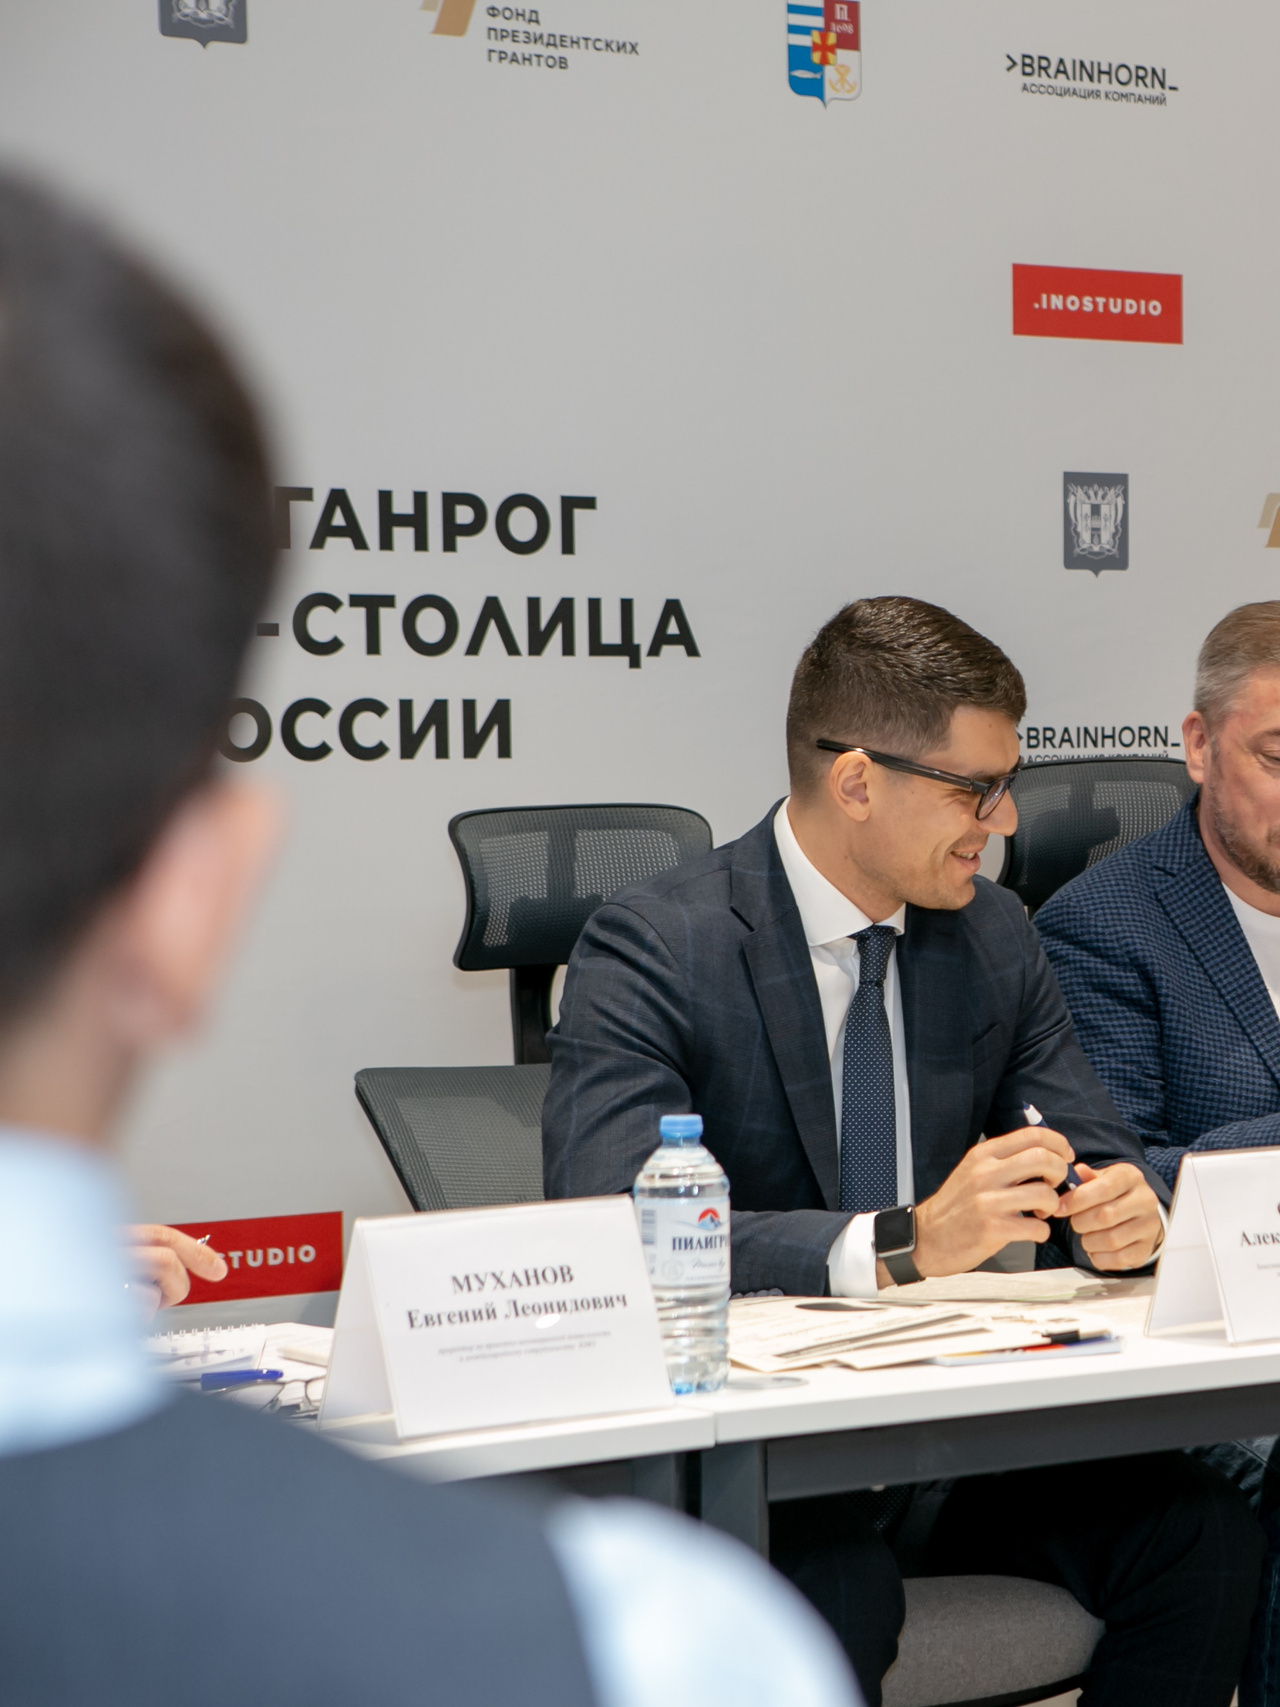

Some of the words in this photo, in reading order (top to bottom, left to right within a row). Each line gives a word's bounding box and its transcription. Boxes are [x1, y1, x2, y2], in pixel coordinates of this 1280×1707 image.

[486, 5, 541, 26] ФОНД
[486, 27, 640, 56] ПРЕЗИДЕНТСКИХ
[487, 49, 569, 70] ГРАНТОВ
[1021, 82, 1101, 100] АССОЦИАЦИЯ
[1104, 91, 1167, 107] КОМПАНИЙ
[273, 485, 598, 556] ГАНРОГ
[217, 697, 513, 763] ОССИИ
[451, 1265, 575, 1296] МУХАНОВ
[406, 1303, 498, 1331] Евгений
[503, 1293, 628, 1320] Леонидович
